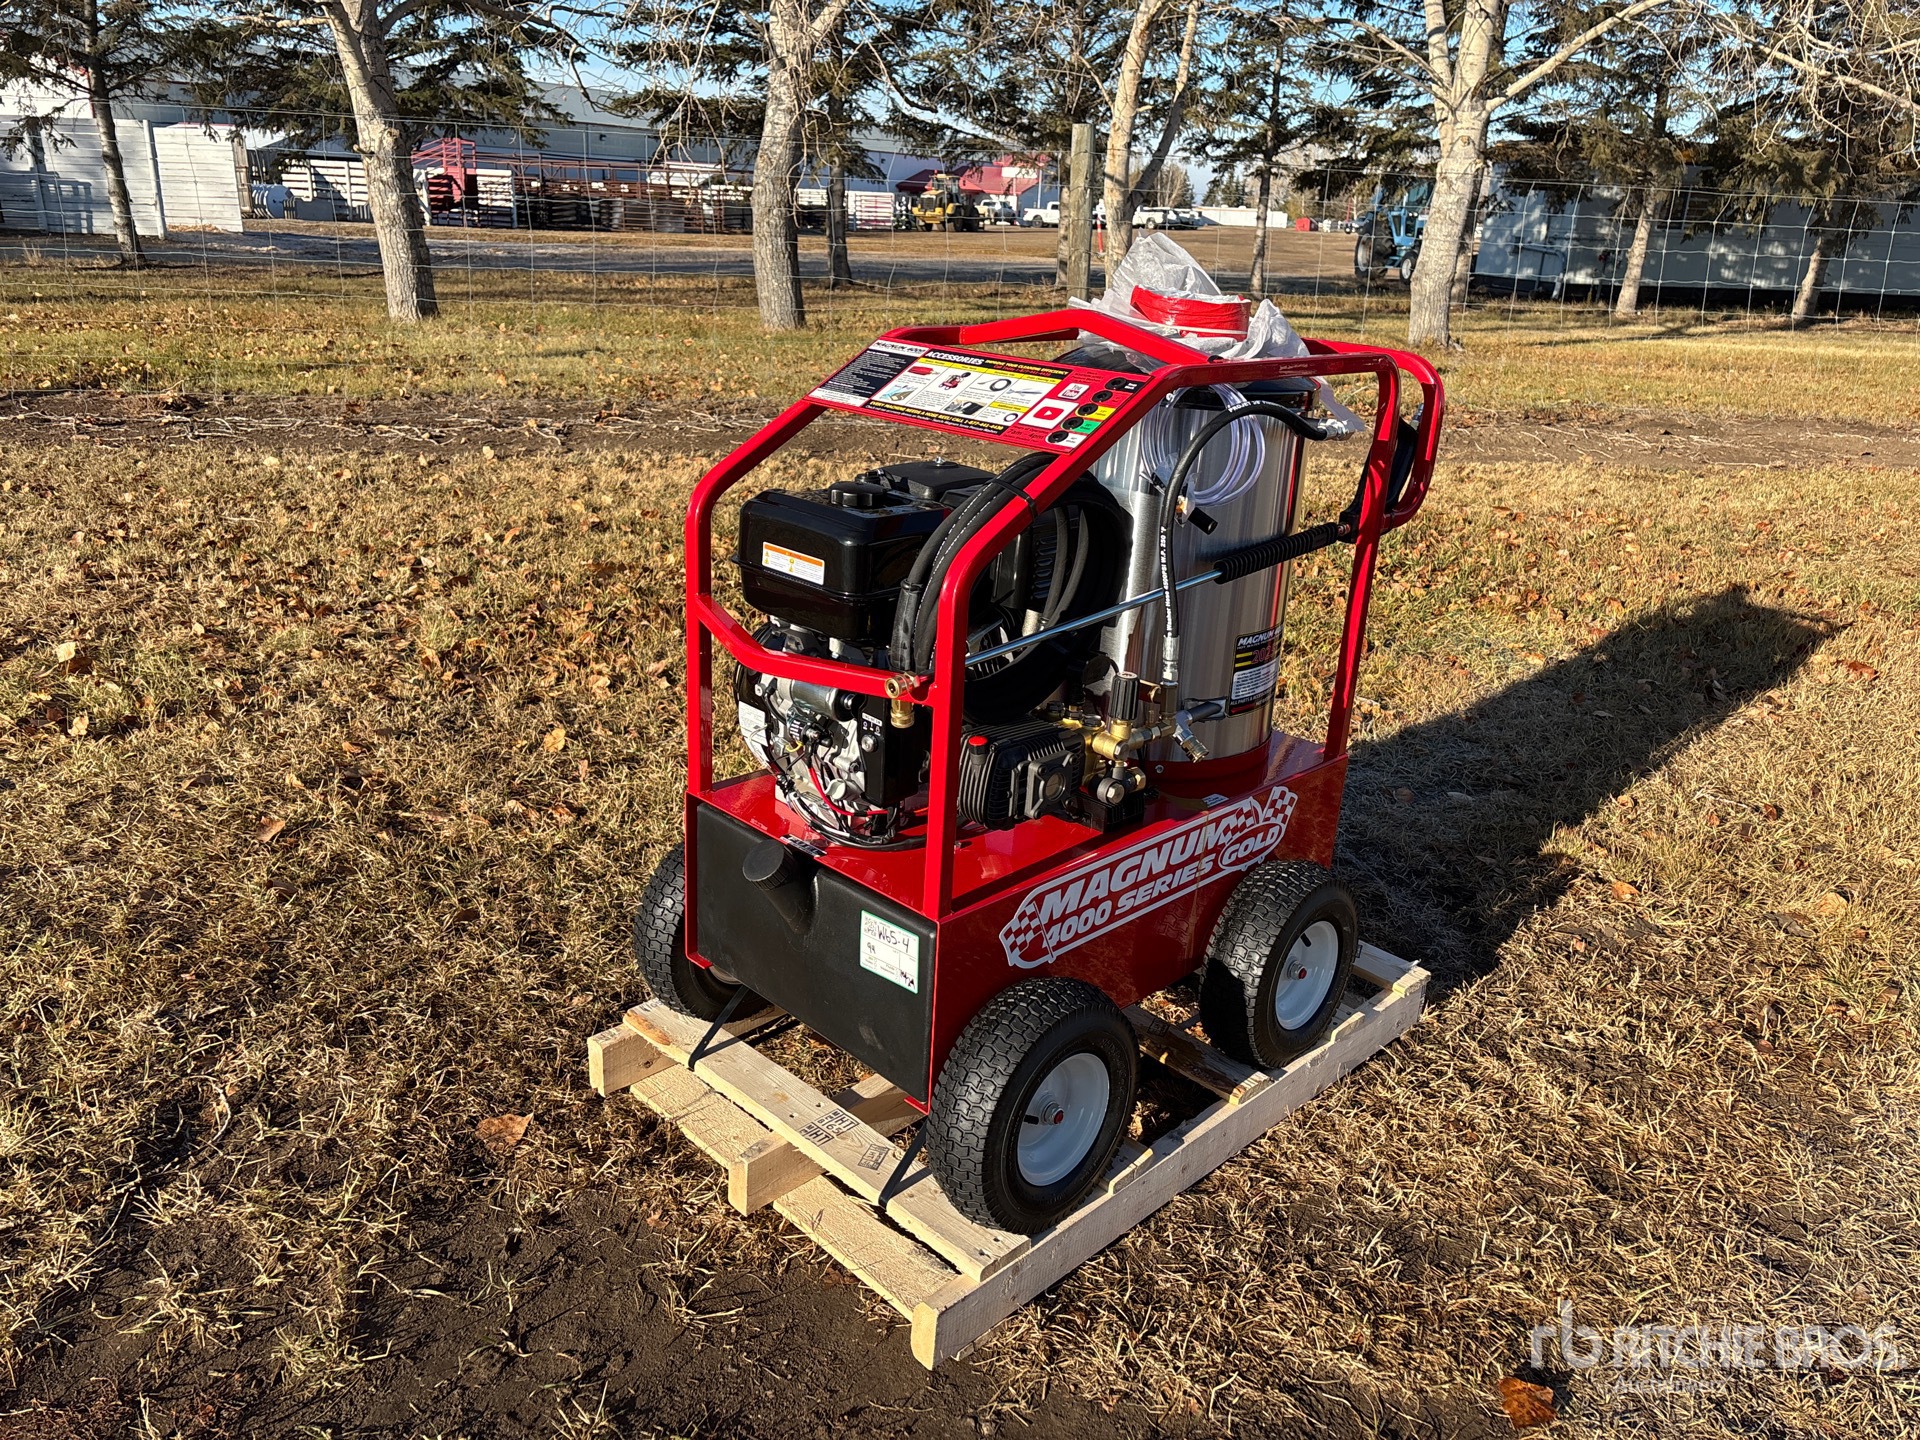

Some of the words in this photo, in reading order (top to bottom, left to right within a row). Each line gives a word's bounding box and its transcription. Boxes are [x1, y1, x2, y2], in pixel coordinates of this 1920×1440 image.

[926, 352, 984, 366] ACCESSORIES
[1021, 364, 1040, 372] CLEANING
[1041, 367, 1068, 376] EFFICIENCY
[1028, 432, 1044, 440] 4pm
[1238, 630, 1274, 646] MAGNUM
[1223, 828, 1278, 864] GOLD
[1040, 814, 1240, 924] MAGNUM
[1042, 902, 1112, 948] 4000
[1115, 854, 1216, 916] SERIES
[835, 1114, 855, 1128] HT
[809, 1128, 828, 1142] HT
[826, 1123, 842, 1134] 65
